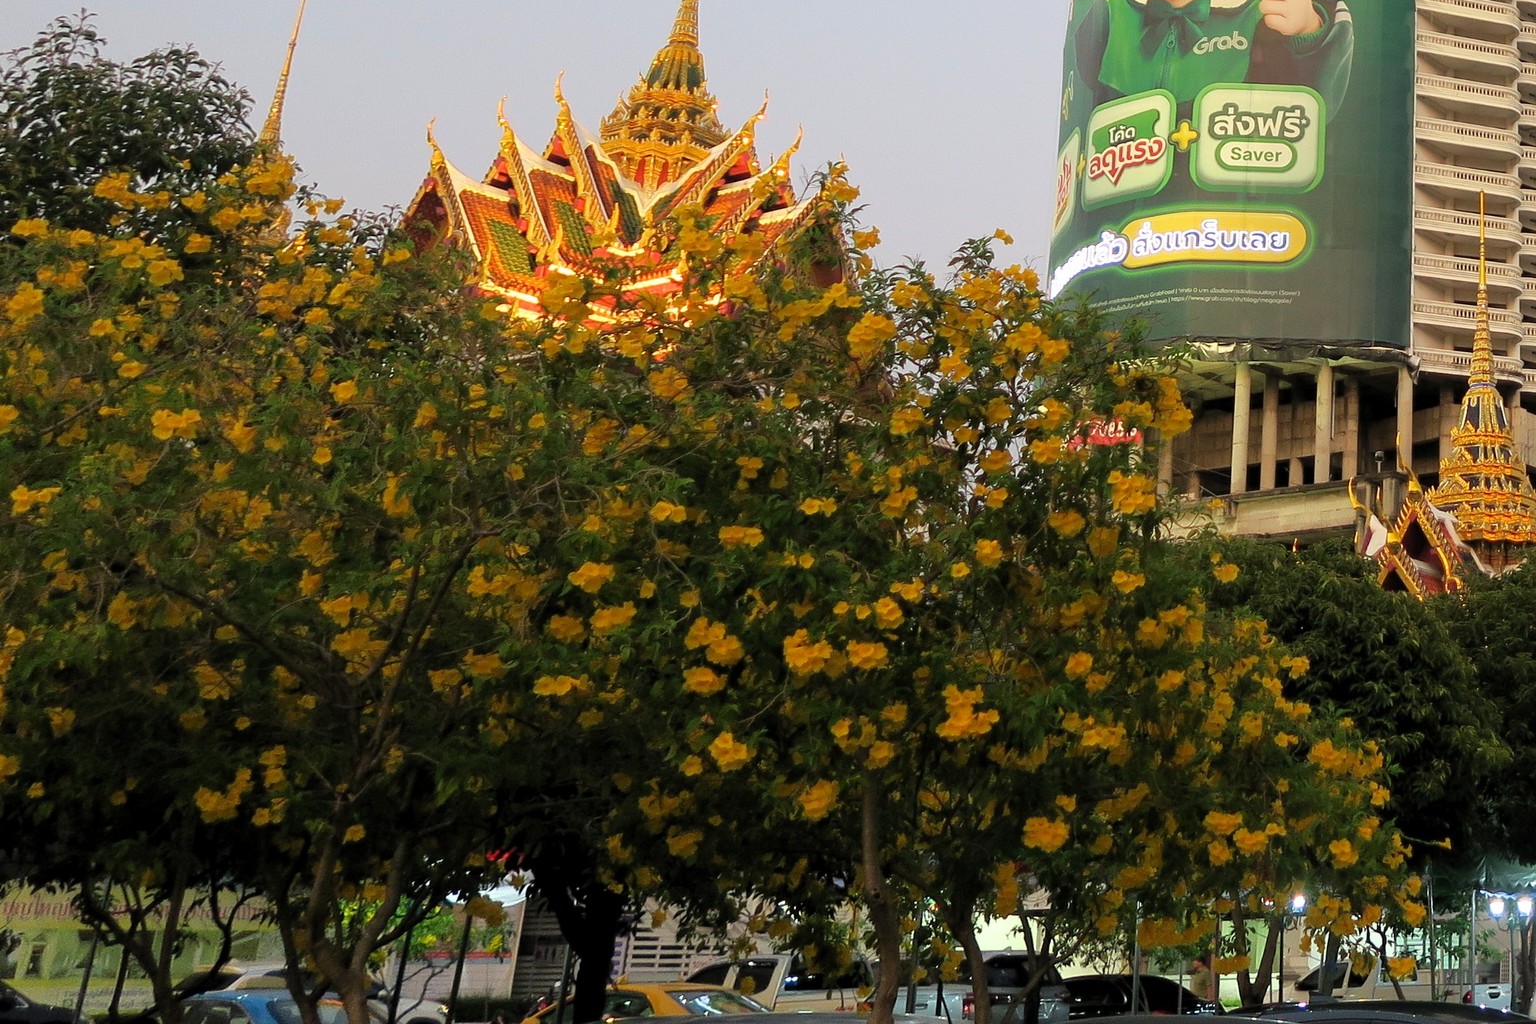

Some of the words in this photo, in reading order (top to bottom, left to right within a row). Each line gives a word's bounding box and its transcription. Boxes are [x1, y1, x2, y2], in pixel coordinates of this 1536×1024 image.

[1193, 30, 1248, 55] Grab
[1109, 126, 1136, 144] โค้ด
[1090, 138, 1166, 181] ลดแรง
[1230, 146, 1282, 162] Saver
[1132, 218, 1290, 258] สั่งแกร็บเลย
